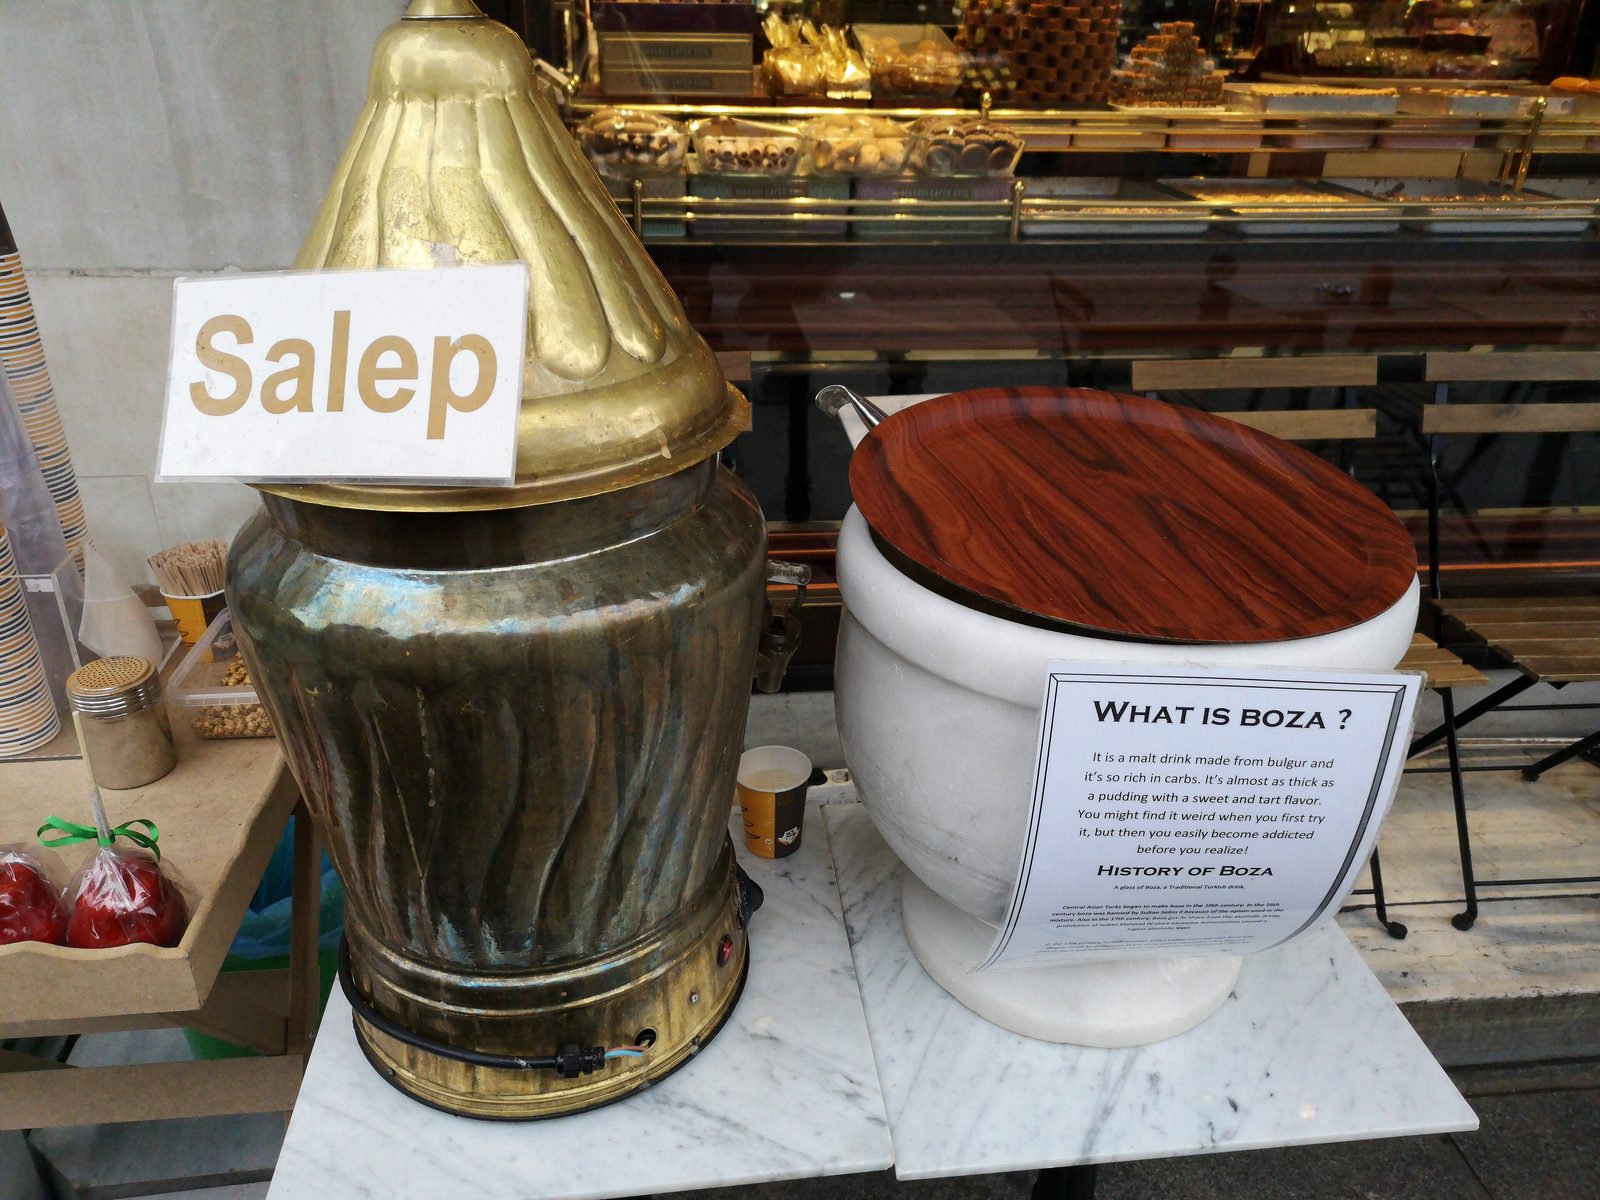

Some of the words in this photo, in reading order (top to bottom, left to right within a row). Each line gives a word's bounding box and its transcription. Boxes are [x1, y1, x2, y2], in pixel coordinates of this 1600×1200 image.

[189, 310, 497, 439] Salep
[1093, 700, 1194, 724] WHAT
[1202, 707, 1231, 725] IS
[1240, 709, 1326, 729] BOZA
[1339, 709, 1352, 730] ?
[1093, 752, 1101, 762] It
[1105, 753, 1114, 763] is
[1118, 755, 1125, 763] a
[1129, 753, 1156, 764] malt
[1160, 753, 1191, 765] drink
[1195, 754, 1230, 766] made
[1234, 755, 1263, 767] from
[1268, 757, 1307, 769] bulgur
[1310, 758, 1334, 769] and
[1084, 772, 1102, 782] it's
[1106, 774, 1120, 783] so
[1124, 772, 1146, 783] rich
[1150, 773, 1161, 783] in
[1164, 773, 1200, 784] carbs.
[1205, 774, 1223, 785] It's
[1227, 775, 1268, 786] almost
[1272, 779, 1285, 787] as
[1288, 776, 1318, 787] thick
[1321, 779, 1334, 788] as
[1098, 791, 1148, 804] pudding
[1152, 792, 1178, 803] with
[1182, 795, 1189, 803] a
[1192, 794, 1228, 804] sweet
[1232, 793, 1255, 804] and
[1259, 795, 1280, 805] tart
[1284, 794, 1322, 806] flavor.
[1078, 810, 1100, 820] You
[1104, 810, 1139, 822] might
[1142, 810, 1165, 821] find
[1169, 811, 1177, 821] it
[1181, 811, 1215, 822] weird
[1219, 812, 1252, 822] when
[1255, 815, 1277, 825] you
[1281, 813, 1304, 824] first
[1308, 814, 1325, 825] try
[1079, 827, 1091, 838] it,
[1094, 827, 1114, 837] but
[1118, 828, 1145, 838] then
[1149, 831, 1171, 840] you
[1174, 828, 1207, 840] easily
[1211, 829, 1258, 839] become
[1262, 829, 1314, 840] addicted
[1136, 845, 1176, 854] before
[1180, 847, 1201, 856] you
[1205, 845, 1248, 855] realize!
[1097, 865, 1184, 876] HISTORY
[1188, 867, 1215, 876] OF
[1219, 865, 1273, 876] BOZA
